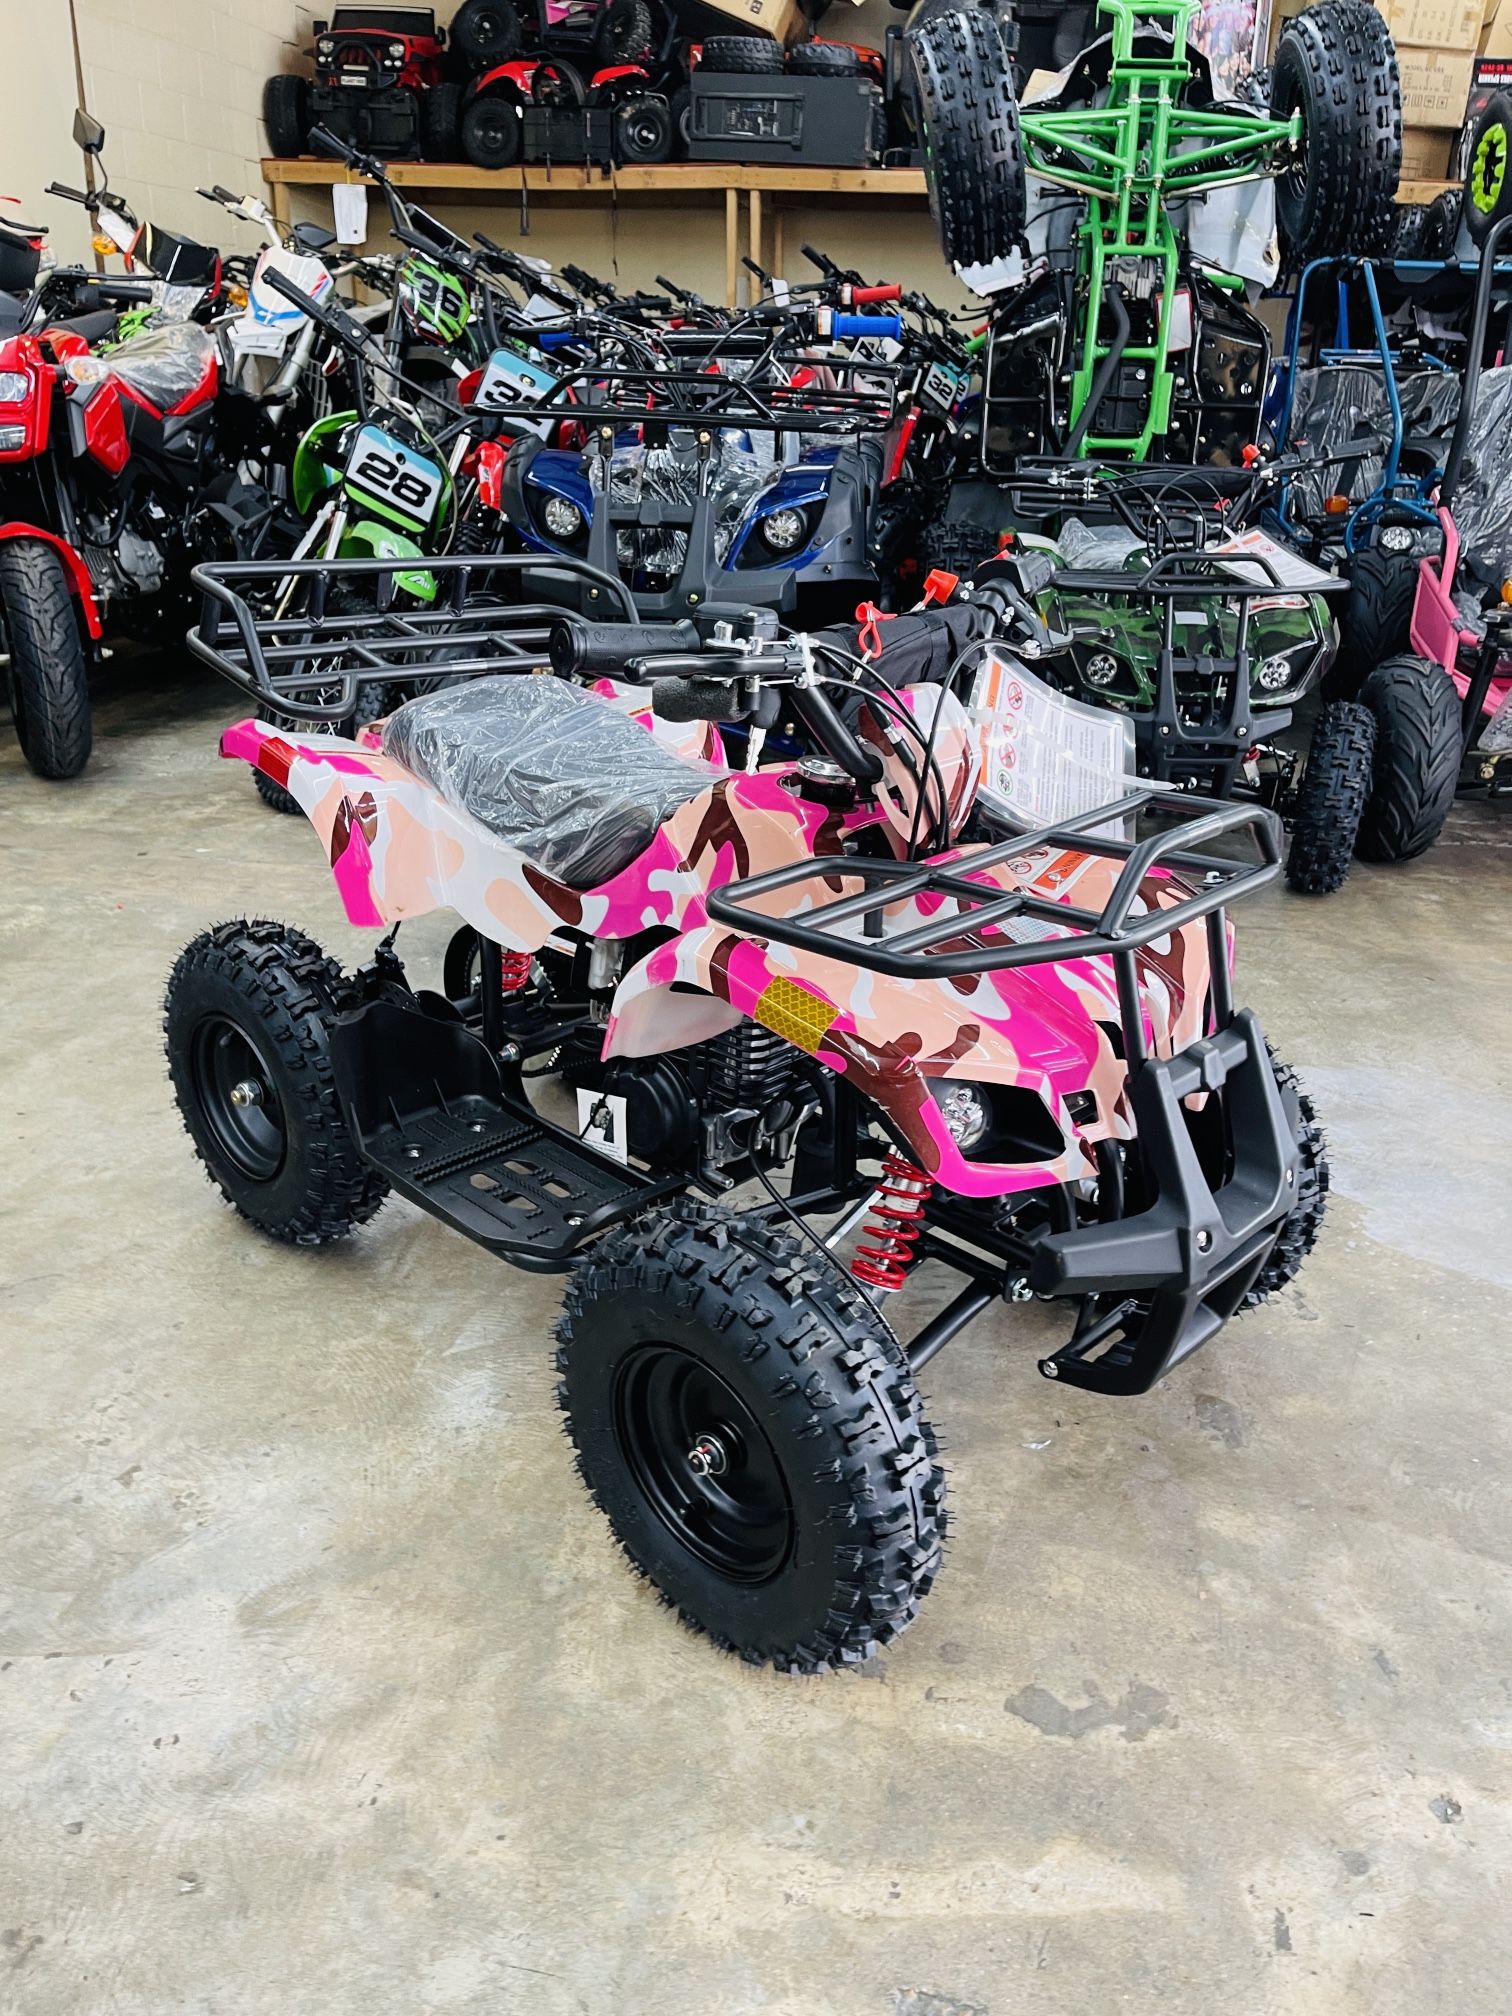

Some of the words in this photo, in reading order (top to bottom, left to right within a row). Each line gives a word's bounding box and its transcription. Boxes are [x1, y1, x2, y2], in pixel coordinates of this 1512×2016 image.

[413, 269, 464, 320] 36
[928, 374, 953, 402] 32
[355, 451, 432, 508] 28
